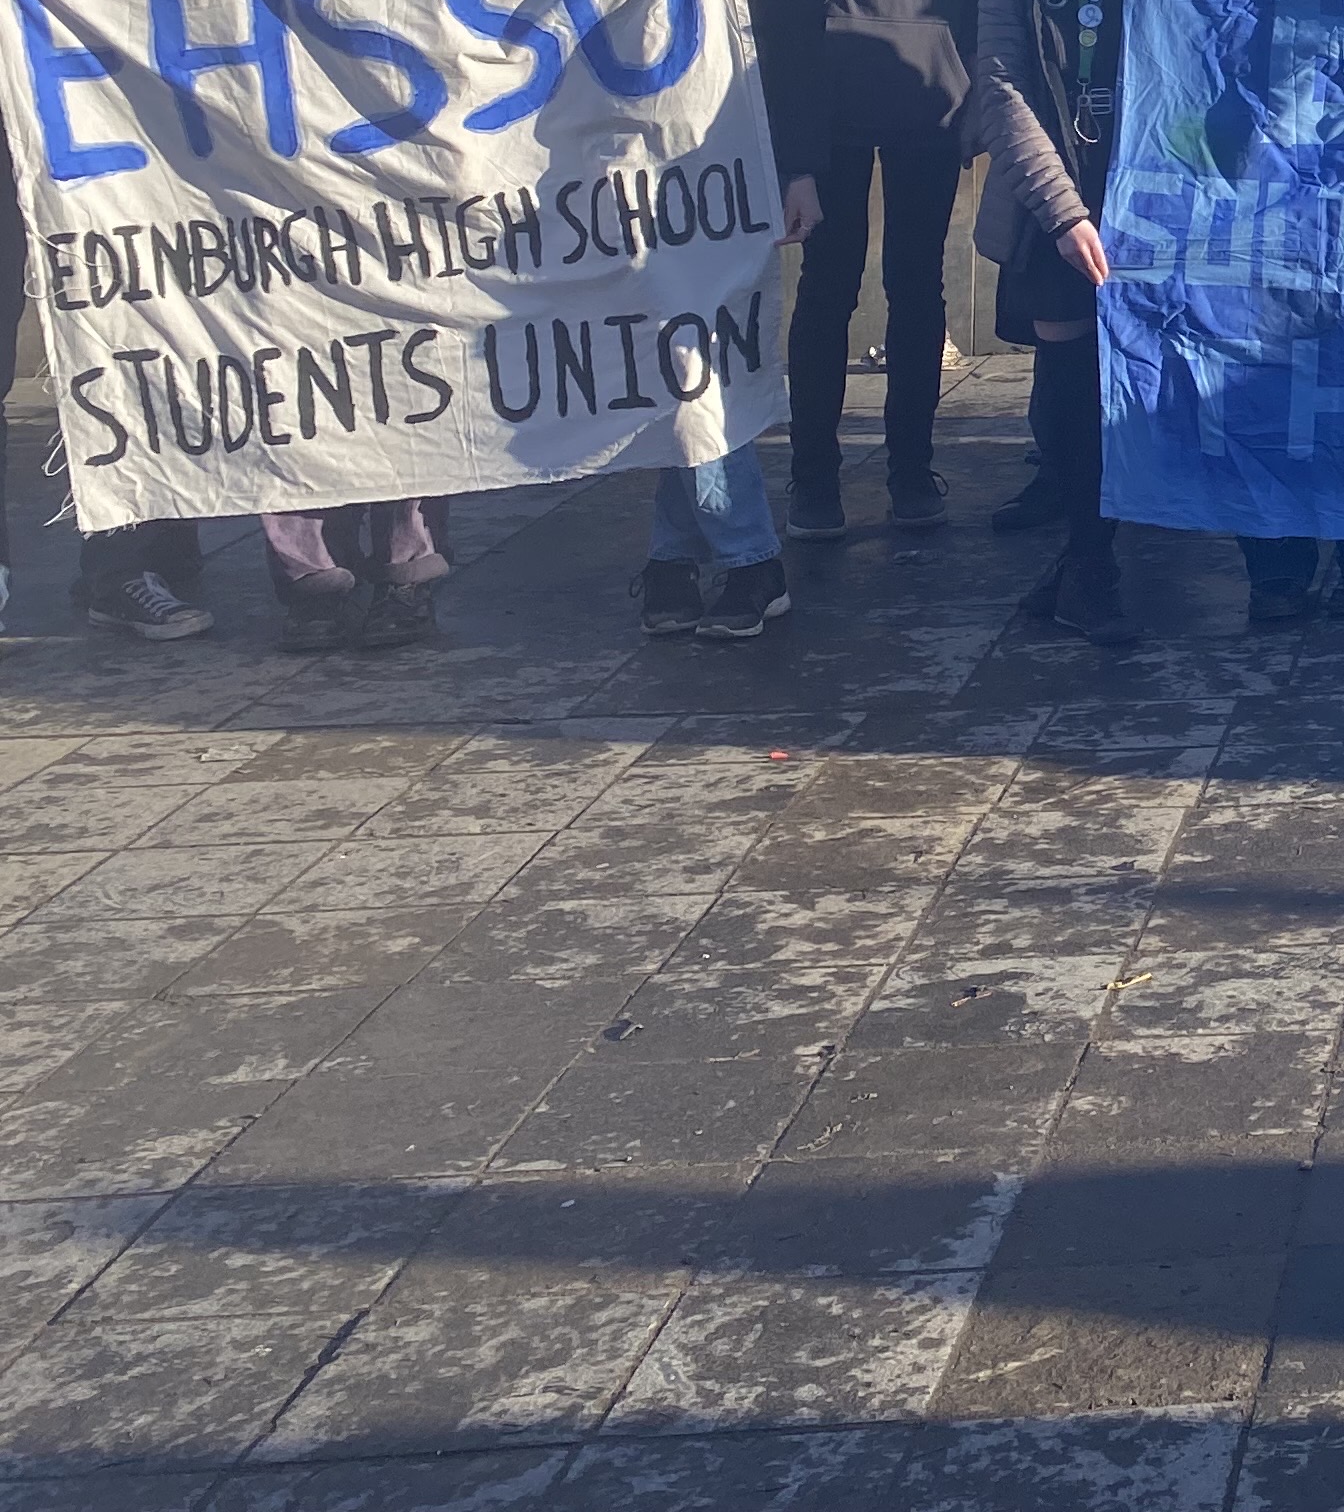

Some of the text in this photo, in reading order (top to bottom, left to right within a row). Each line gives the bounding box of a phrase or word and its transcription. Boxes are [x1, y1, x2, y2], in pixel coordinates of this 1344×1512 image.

[47, 157, 771, 312] EDINBURGH HIGH SCHOOL
[71, 291, 762, 468] STUDENTS UNION
